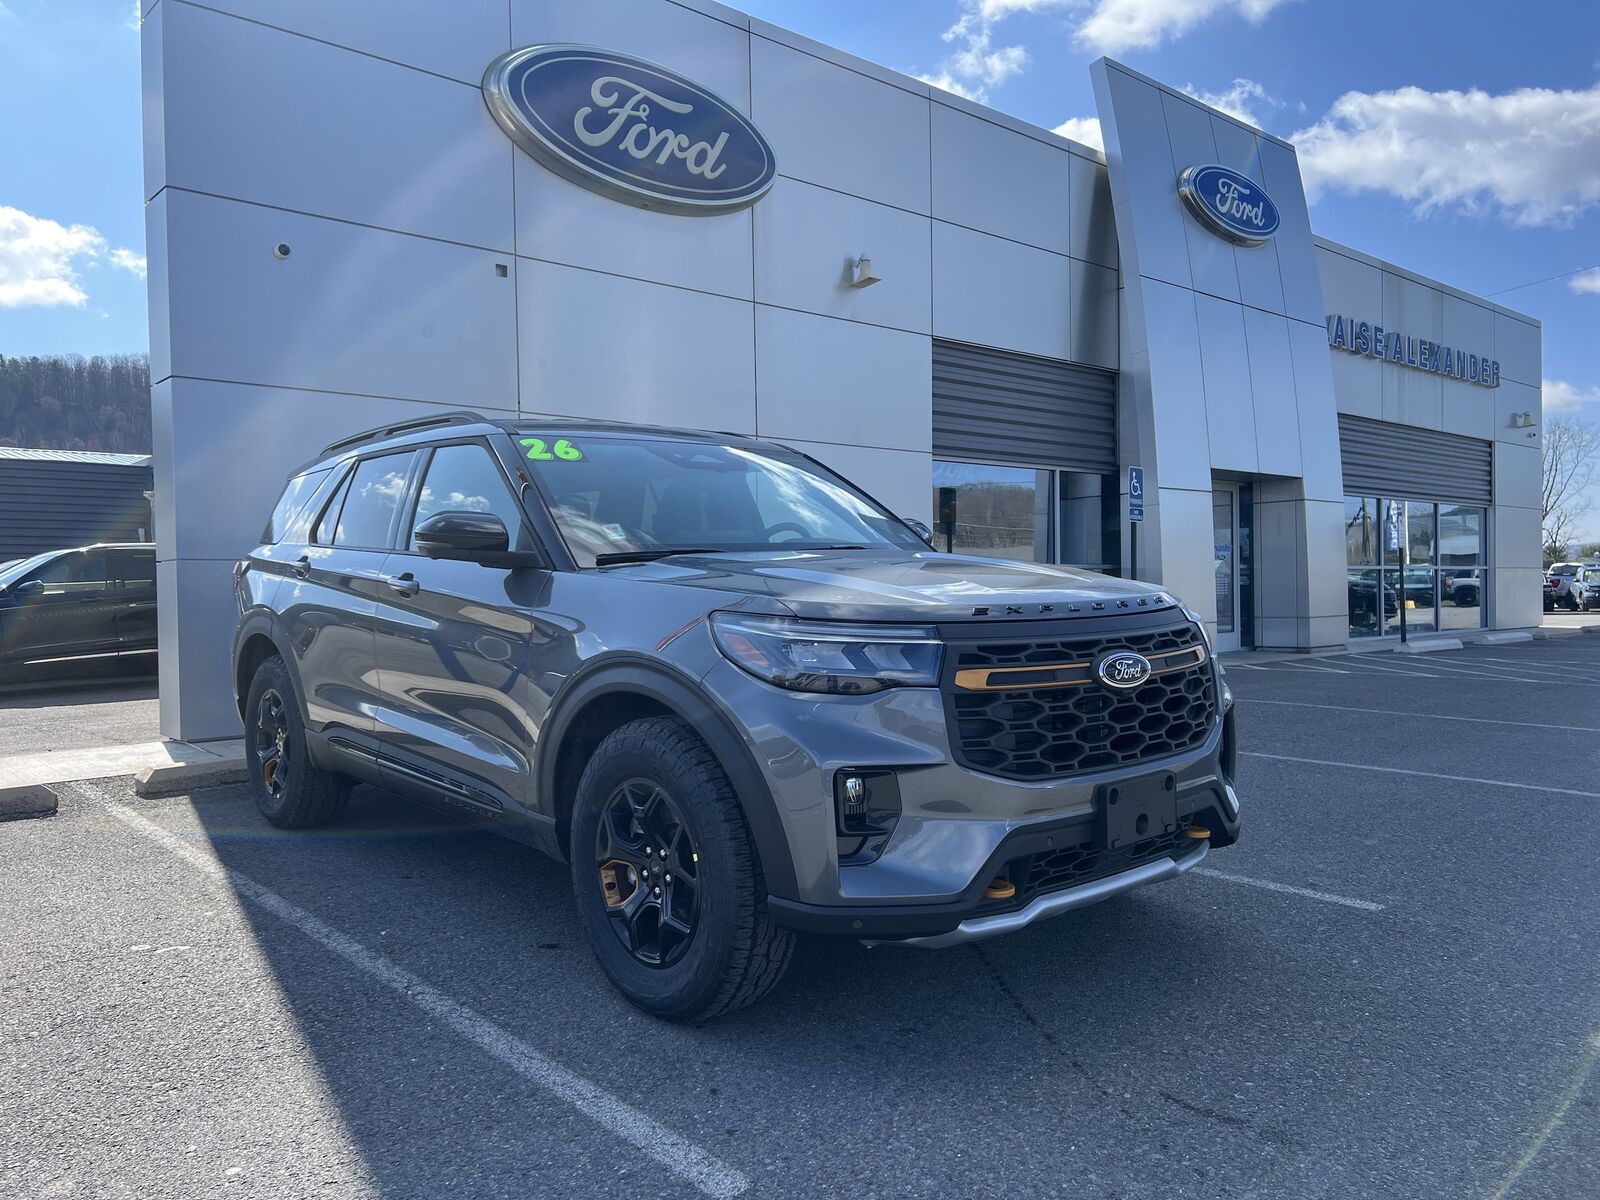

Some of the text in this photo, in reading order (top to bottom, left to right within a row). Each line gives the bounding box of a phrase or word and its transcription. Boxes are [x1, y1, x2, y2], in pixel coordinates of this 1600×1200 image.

[574, 76, 730, 180] Ford
[1215, 178, 1265, 227] Ford
[1327, 314, 1500, 388] AISE ALEXANDER
[519, 438, 583, 460] 26
[971, 595, 1165, 616] EXPLORER
[1114, 659, 1142, 680] Ford
